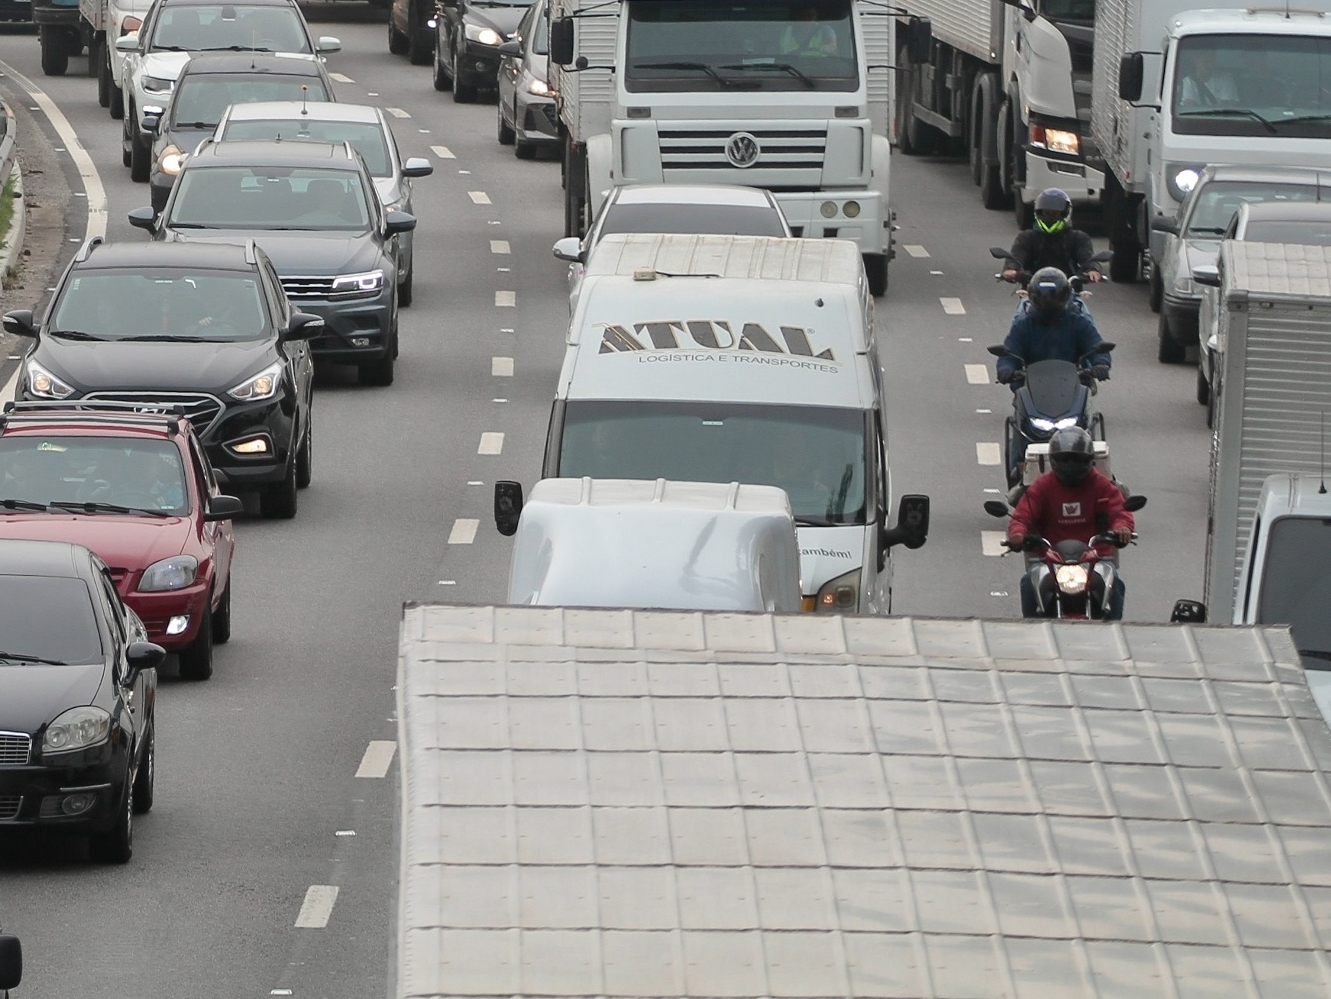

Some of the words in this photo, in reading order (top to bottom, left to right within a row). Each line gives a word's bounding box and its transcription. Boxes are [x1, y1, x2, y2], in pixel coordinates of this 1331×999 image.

[596, 320, 836, 362] ATUAL
[638, 353, 715, 363] LOGÍSTICA
[733, 355, 838, 374] TRANSPORTES
